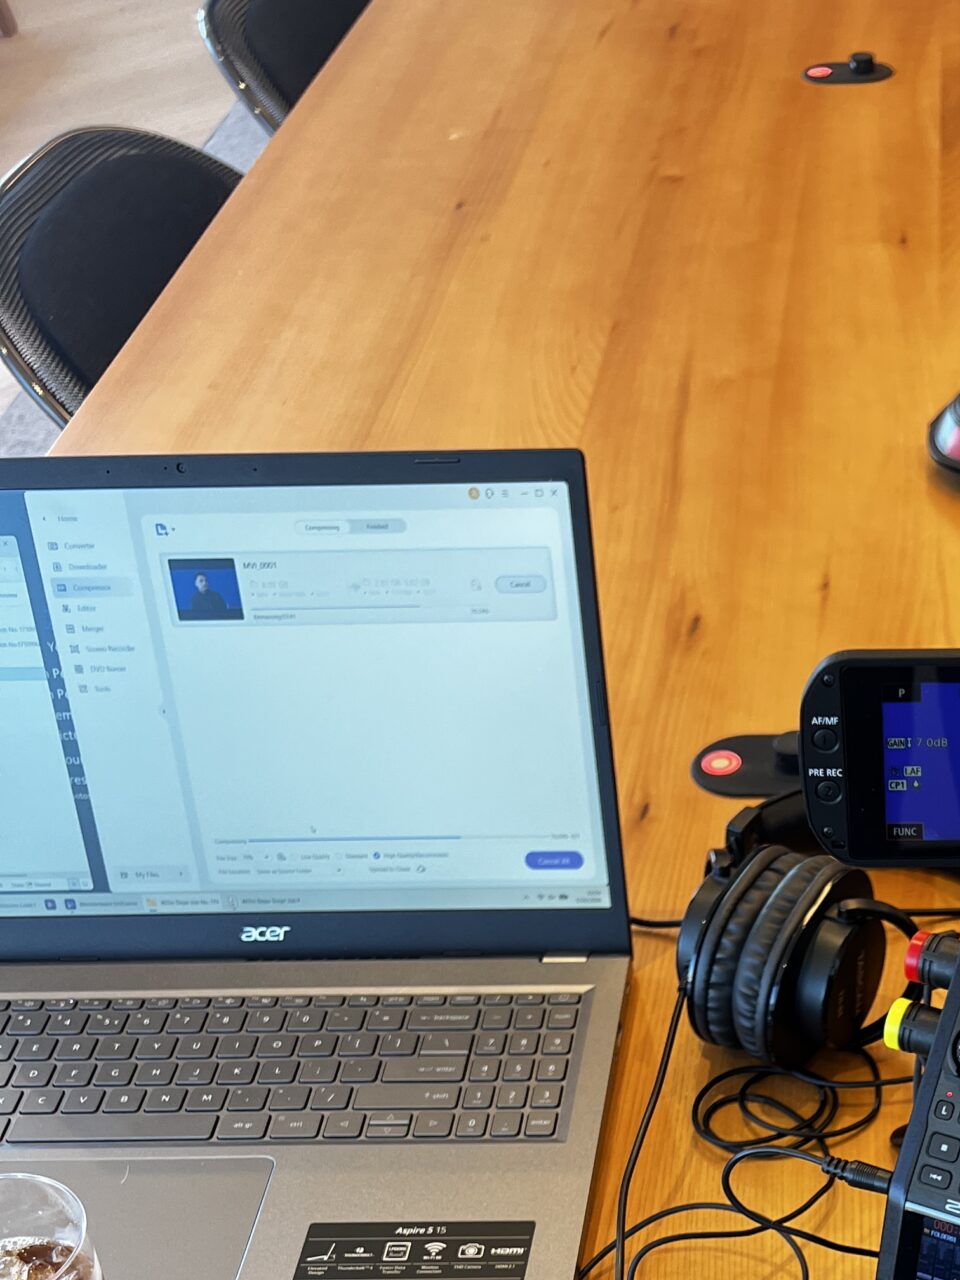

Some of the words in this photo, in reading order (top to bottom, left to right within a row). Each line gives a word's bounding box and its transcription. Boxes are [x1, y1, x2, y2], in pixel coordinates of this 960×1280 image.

[898, 688, 906, 698] P
[811, 716, 839, 726] AF/MF
[888, 738, 905, 748] GAIN
[808, 768, 824, 777] PRE
[826, 768, 843, 777] REC
[894, 827, 917, 836] FUNC
[240, 925, 292, 942] acer
[72, 1043, 80, 1051] R
[154, 1042, 161, 1050] Y
[273, 1040, 282, 1048] O
[71, 1069, 78, 1077] F
[111, 1069, 119, 1077] G
[152, 1068, 161, 1076] H
[233, 1067, 241, 1075] K
[275, 1067, 281, 1075] L
[38, 1096, 46, 1104] C
[120, 1095, 129, 1103] B
[941, 1106, 948, 1115] L
[395, 1226, 426, 1235] Aspire
[427, 1226, 434, 1235] 5
[436, 1226, 447, 1235] 15
